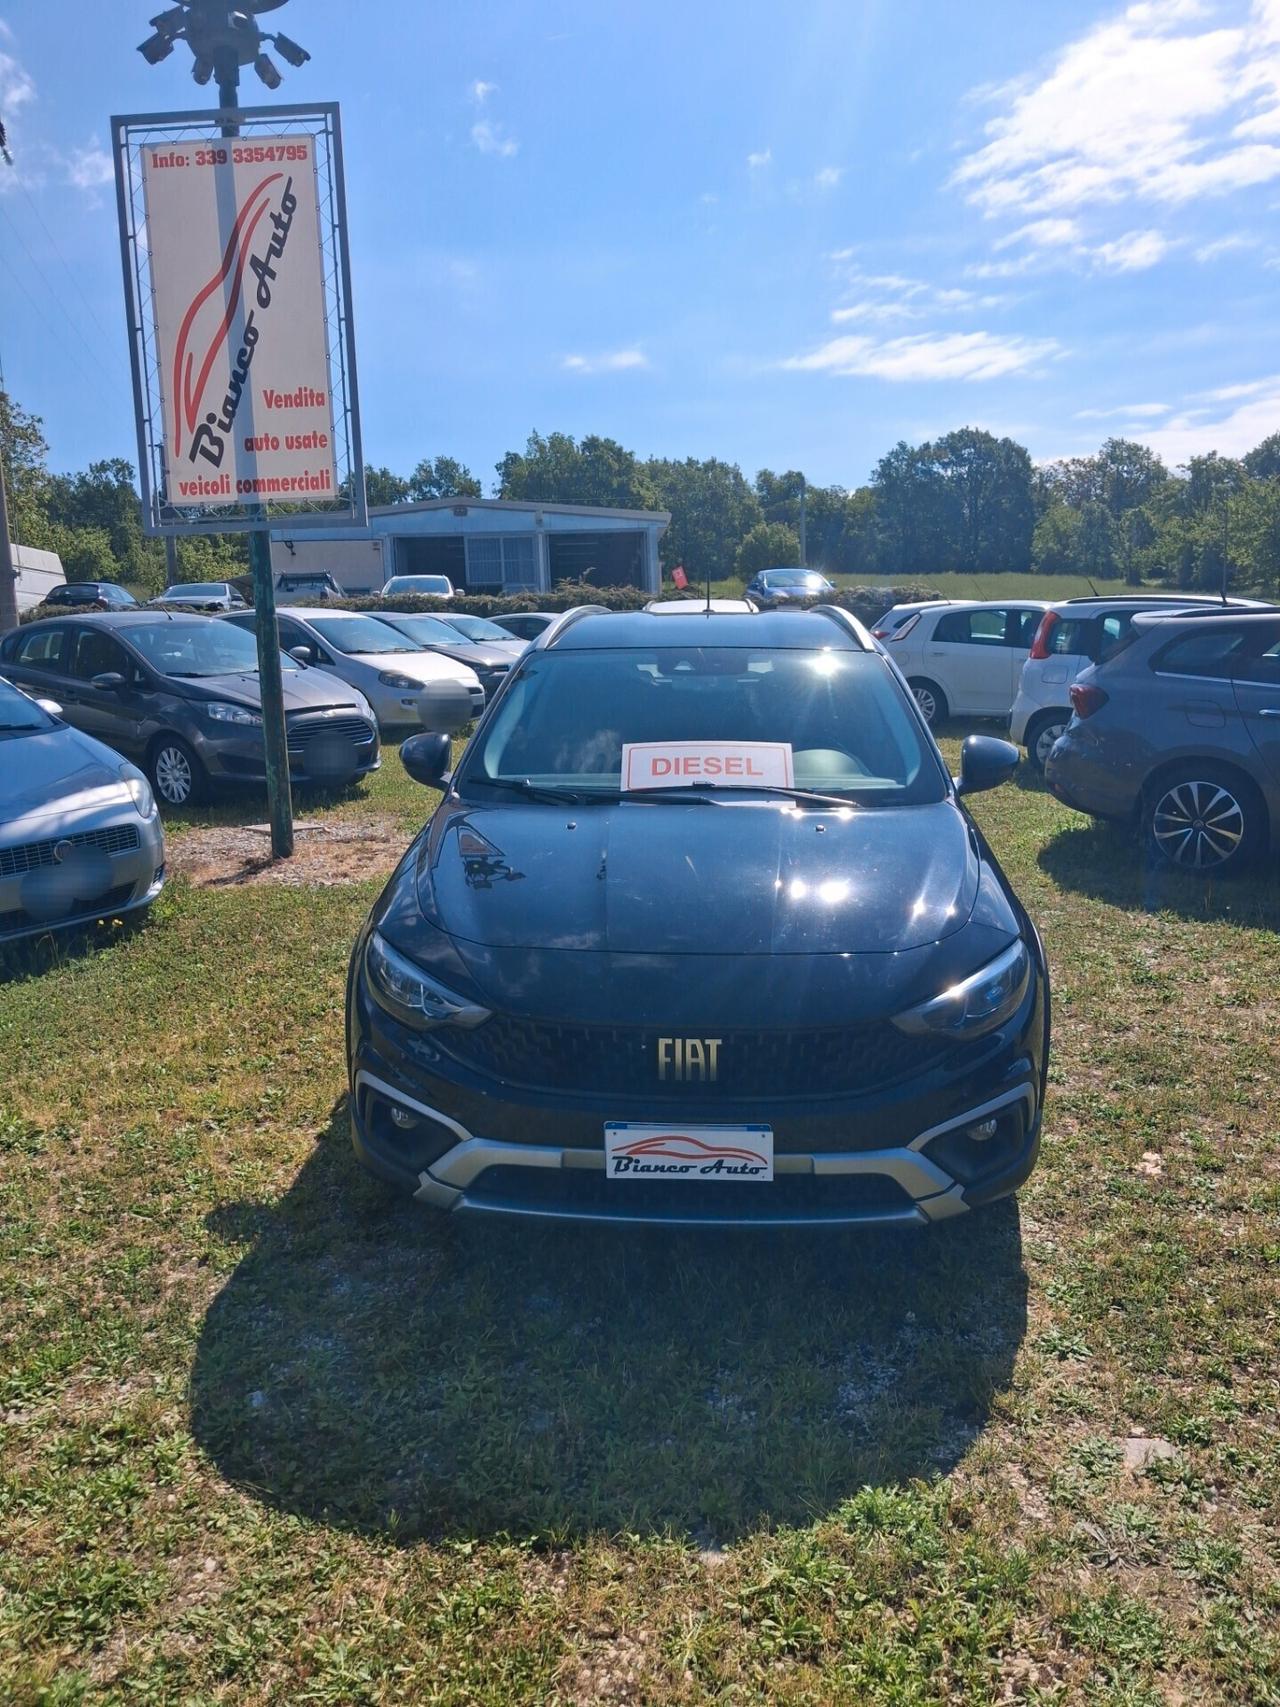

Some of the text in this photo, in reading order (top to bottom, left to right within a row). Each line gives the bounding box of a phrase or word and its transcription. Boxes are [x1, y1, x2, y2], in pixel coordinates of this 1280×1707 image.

[152, 145, 308, 168] Info: 339 3354795
[188, 176, 298, 469] Bianco Auto
[262, 387, 326, 409] Vendita
[244, 430, 328, 452] auto usate
[179, 469, 331, 496] veicoli commerciali
[651, 757, 763, 776] DIESEL
[658, 1038, 722, 1081] FIAT
[612, 1156, 768, 1175] Bianco Auto
